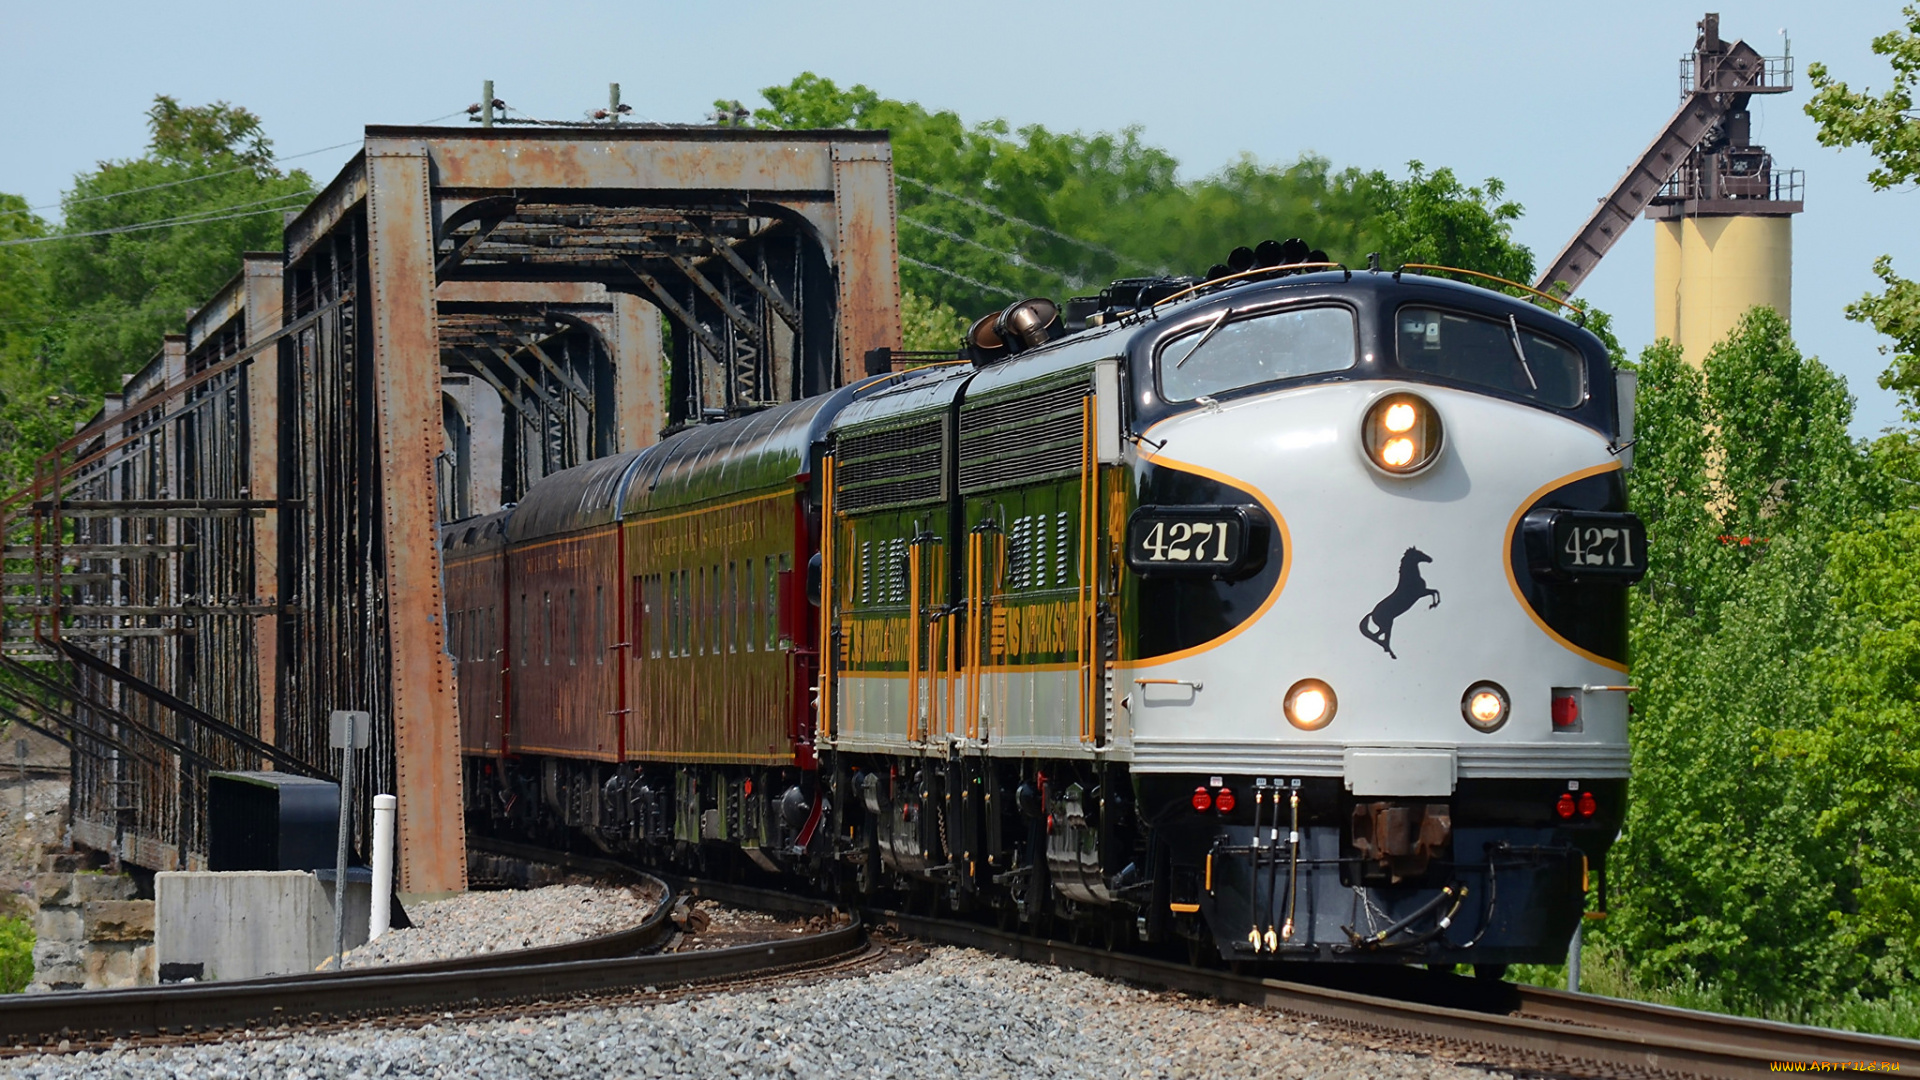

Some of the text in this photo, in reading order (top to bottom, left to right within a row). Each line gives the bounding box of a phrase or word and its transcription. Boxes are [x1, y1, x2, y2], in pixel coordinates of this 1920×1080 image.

[1142, 522, 1229, 562] 4271
[1565, 527, 1635, 567] 4271
[1021, 603, 1054, 655] NORFOLK
